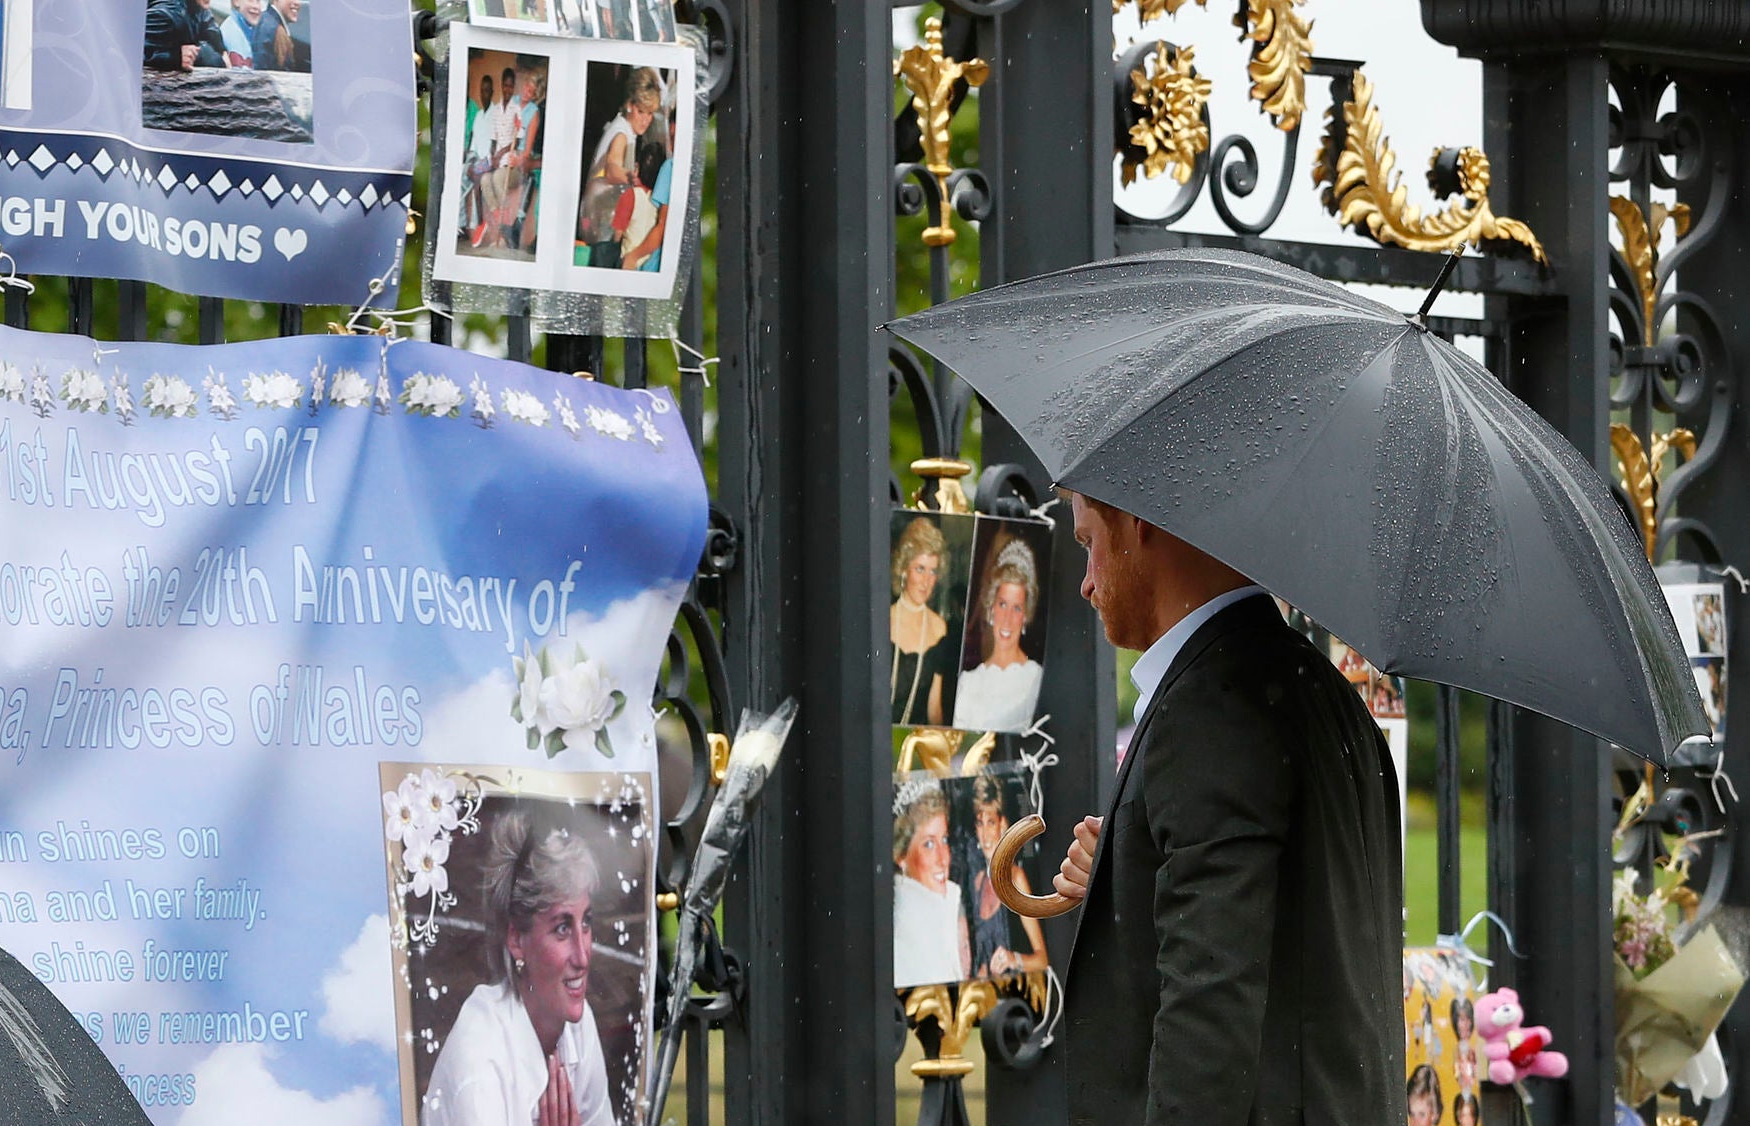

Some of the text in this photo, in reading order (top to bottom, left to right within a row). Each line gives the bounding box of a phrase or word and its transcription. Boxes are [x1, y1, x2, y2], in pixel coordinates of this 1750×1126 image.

[78, 200, 159, 250] YOUR
[164, 216, 263, 263] SONS
[63, 426, 237, 528] August
[245, 425, 319, 505] 2017
[122, 548, 178, 627] the
[177, 544, 279, 627] 20th
[292, 545, 517, 654] Anniversary
[527, 559, 583, 637] of
[41, 666, 235, 750] Princess
[249, 662, 291, 748] of
[39, 820, 167, 862] shines
[178, 824, 221, 858] on
[45, 879, 118, 922] and
[128, 880, 187, 920] her
[193, 878, 268, 930] family.
[33, 938, 229, 984] shine forever
[113, 1010, 152, 1044] we
[158, 1003, 307, 1045] remember
